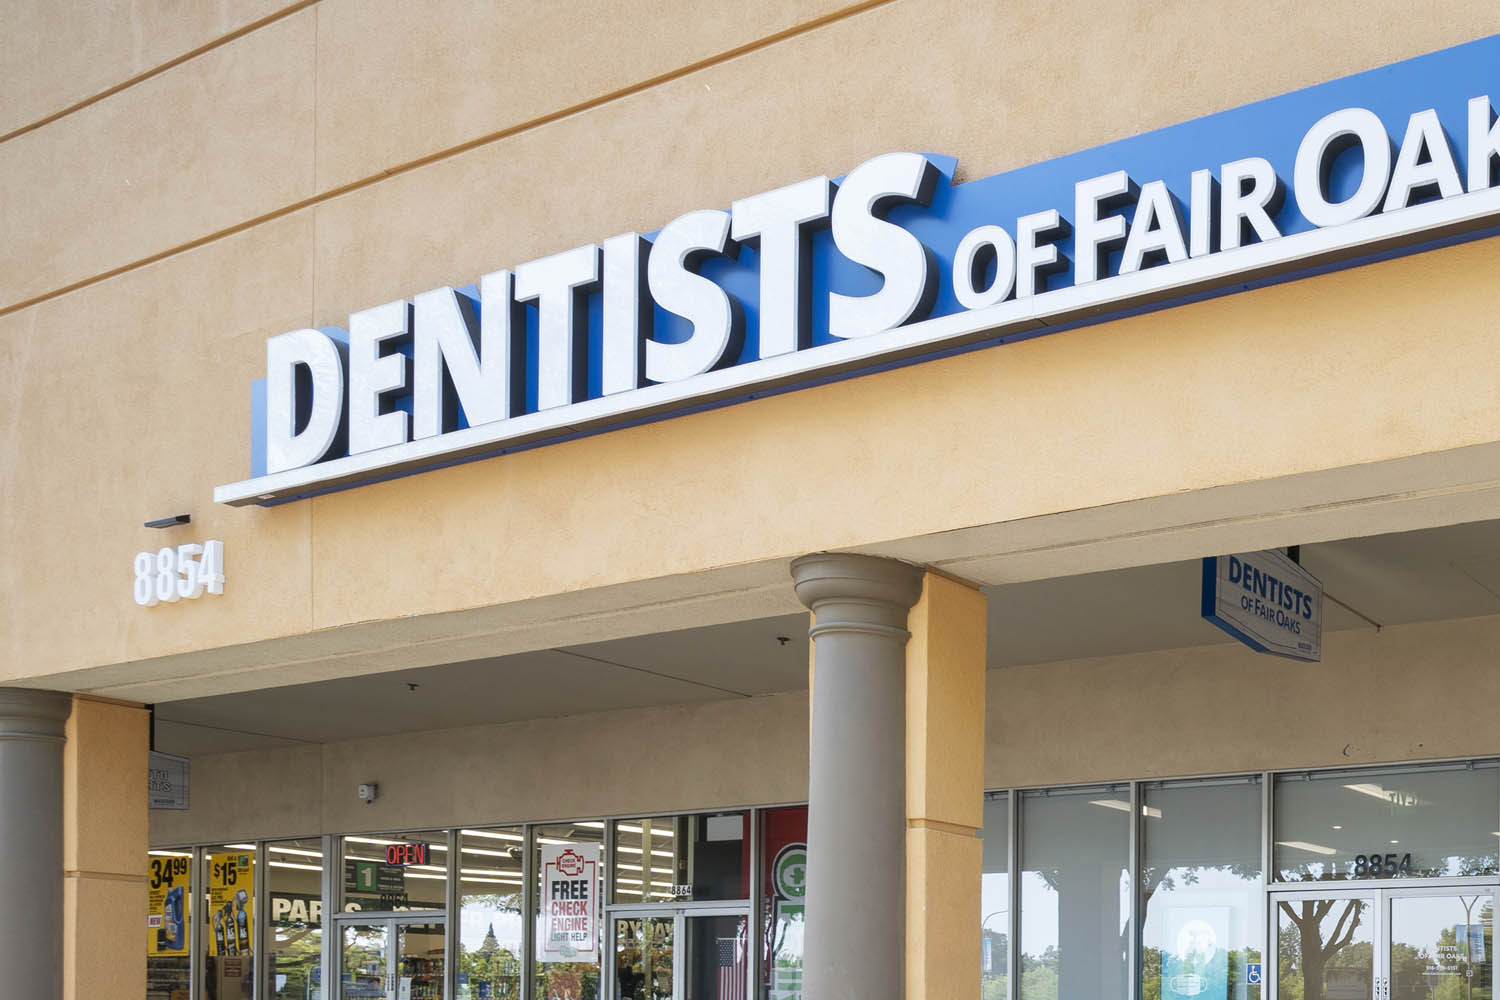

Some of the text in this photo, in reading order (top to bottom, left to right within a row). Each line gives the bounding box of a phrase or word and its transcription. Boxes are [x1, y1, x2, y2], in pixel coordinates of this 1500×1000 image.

[266, 151, 938, 476] DENTISTS
[952, 208, 1068, 310] OF
[1074, 156, 1288, 286] FAIR
[133, 540, 225, 606] 8854
[1229, 555, 1312, 620] DENTISTS
[1241, 595, 1301, 635] OF FAIR OAKS
[387, 843, 425, 865] OPEN
[1355, 853, 1412, 877] 8854
[214, 862, 237, 886] $15
[361, 868, 371, 887] 1
[552, 880, 588, 900] FREE
[672, 886, 691, 895] 8864
[552, 901, 588, 916] CHECK
[552, 917, 588, 931] ENGINE
[551, 932, 587, 941] LIGHT HELP
